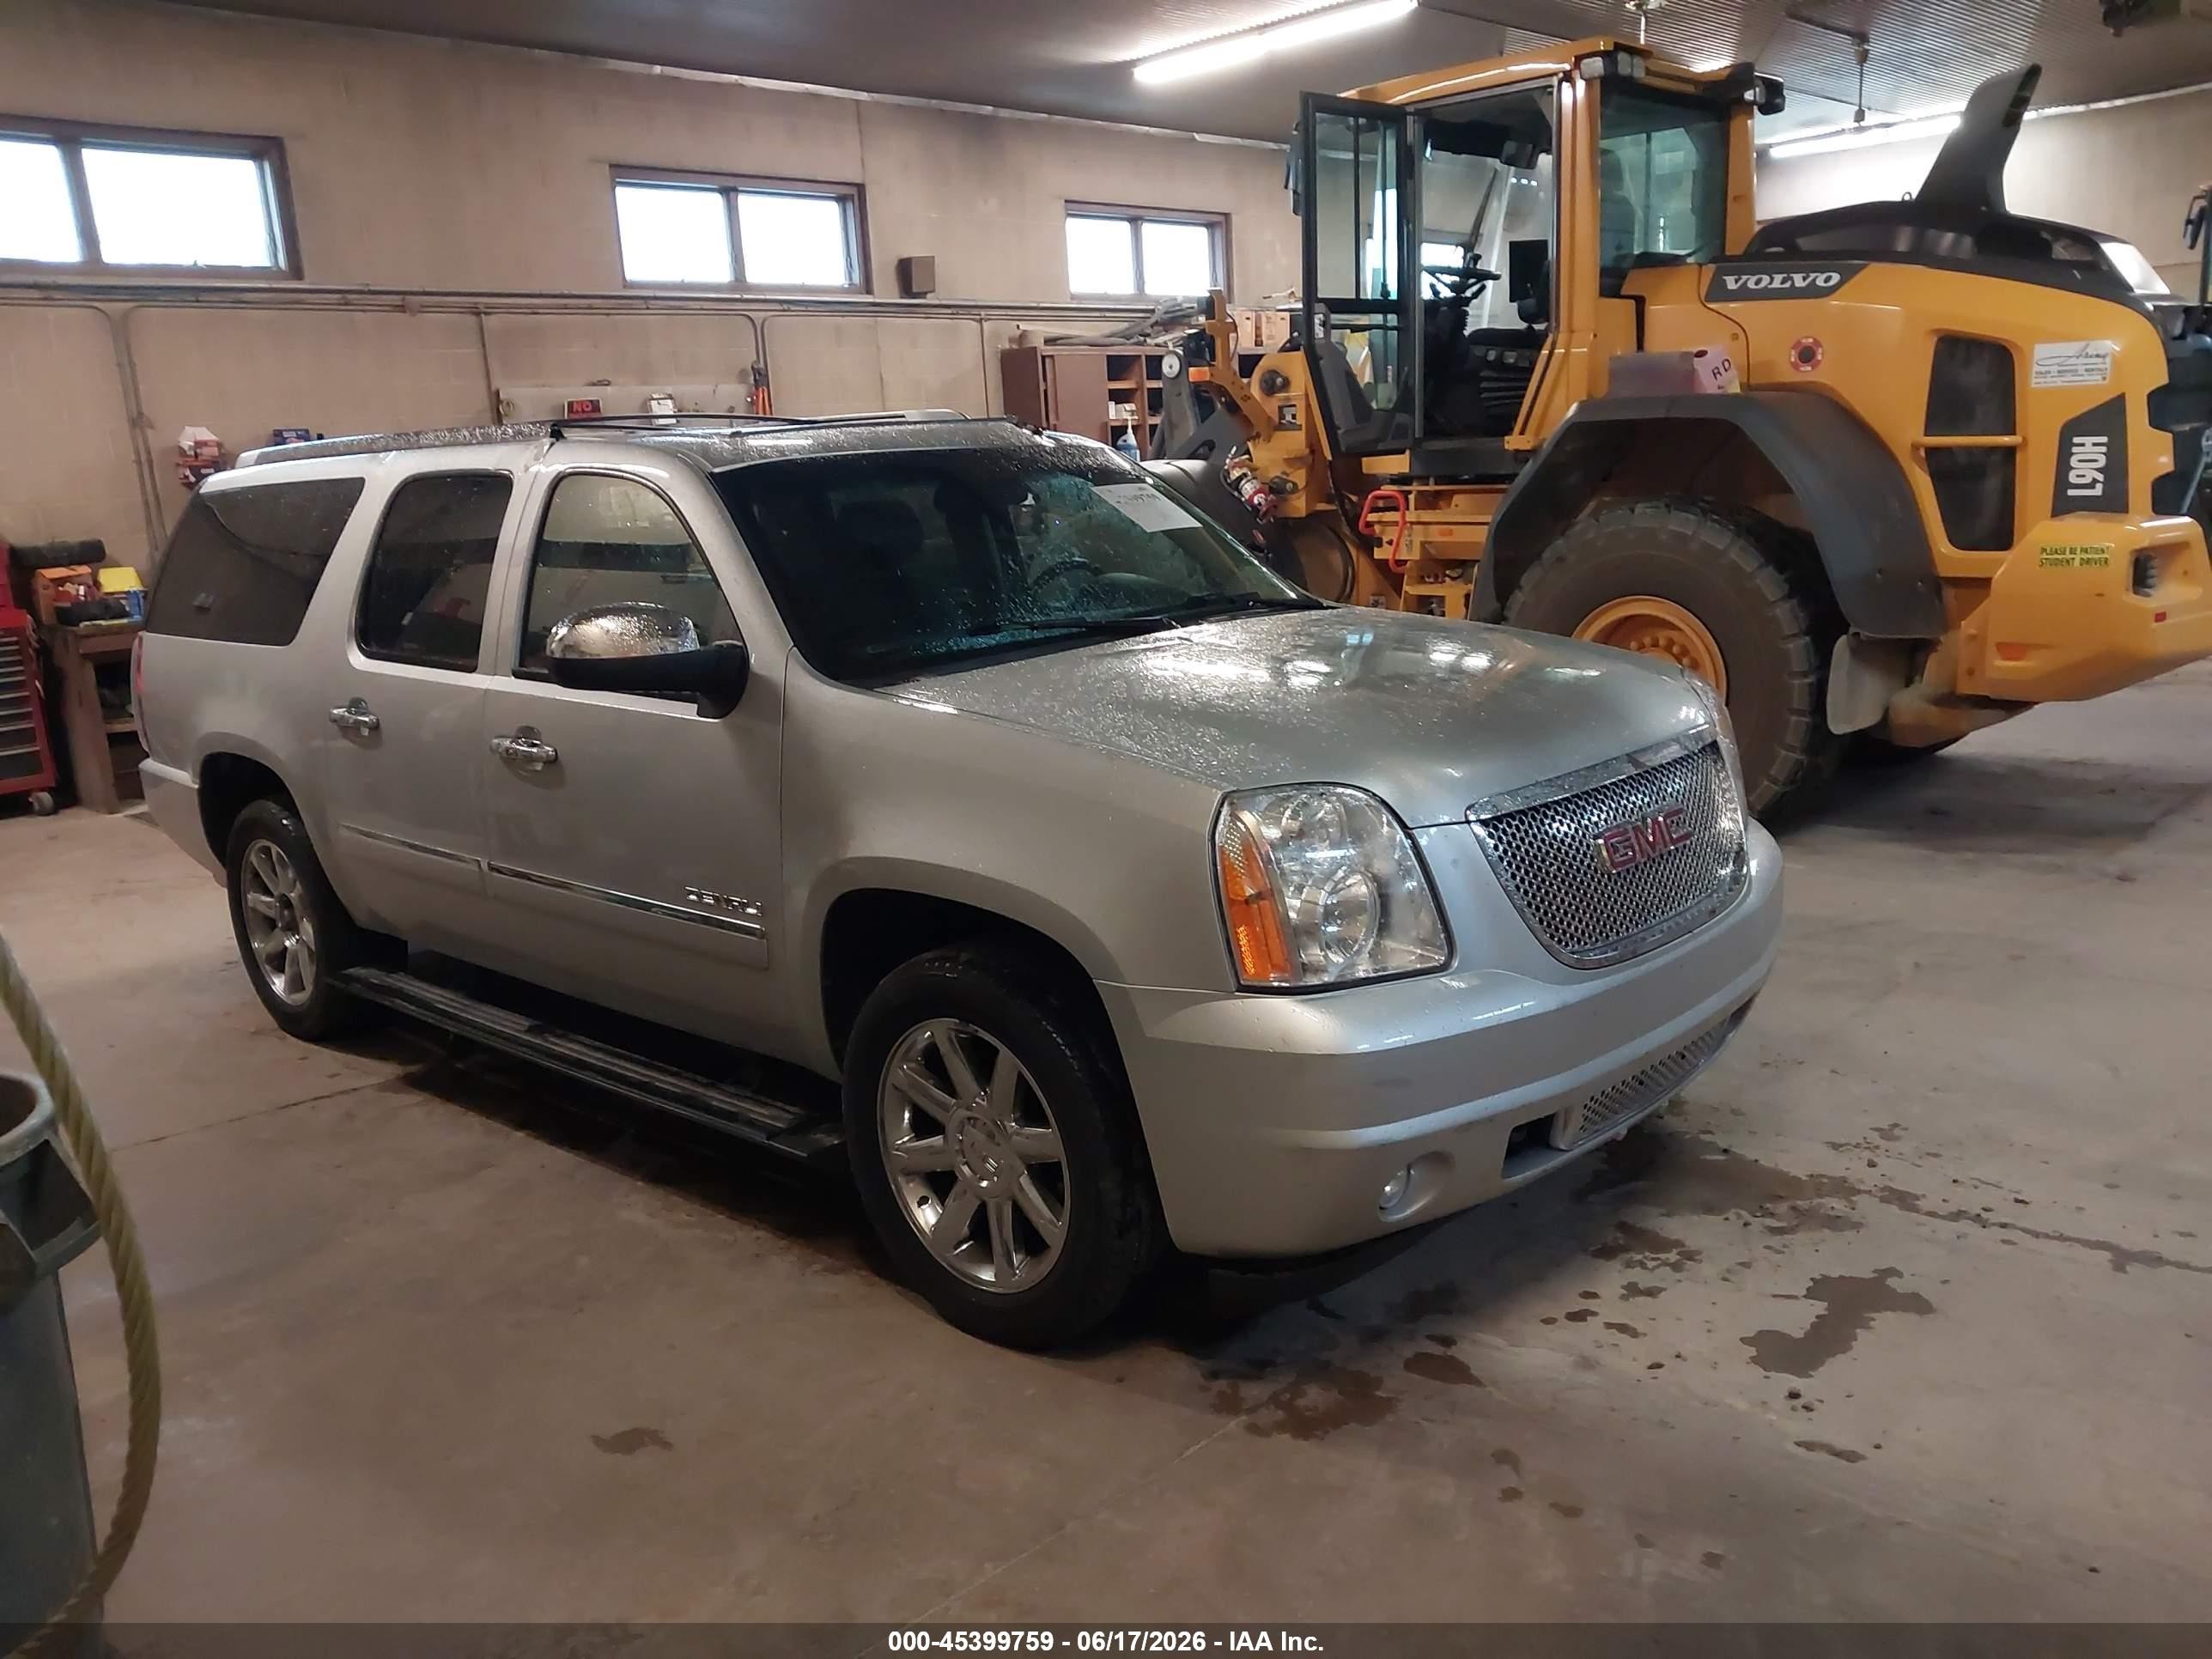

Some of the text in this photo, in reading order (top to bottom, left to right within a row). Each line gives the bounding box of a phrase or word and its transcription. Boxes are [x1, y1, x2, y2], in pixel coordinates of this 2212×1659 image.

[1723, 272, 1841, 290] VOLVO
[573, 401, 592, 412] NO
[2067, 436, 2109, 496] L90H
[2040, 545, 2110, 556] PLEASE BE PATIENT
[2039, 556, 2109, 567] STUDENT DRIVER
[1599, 805, 1692, 871] GMC
